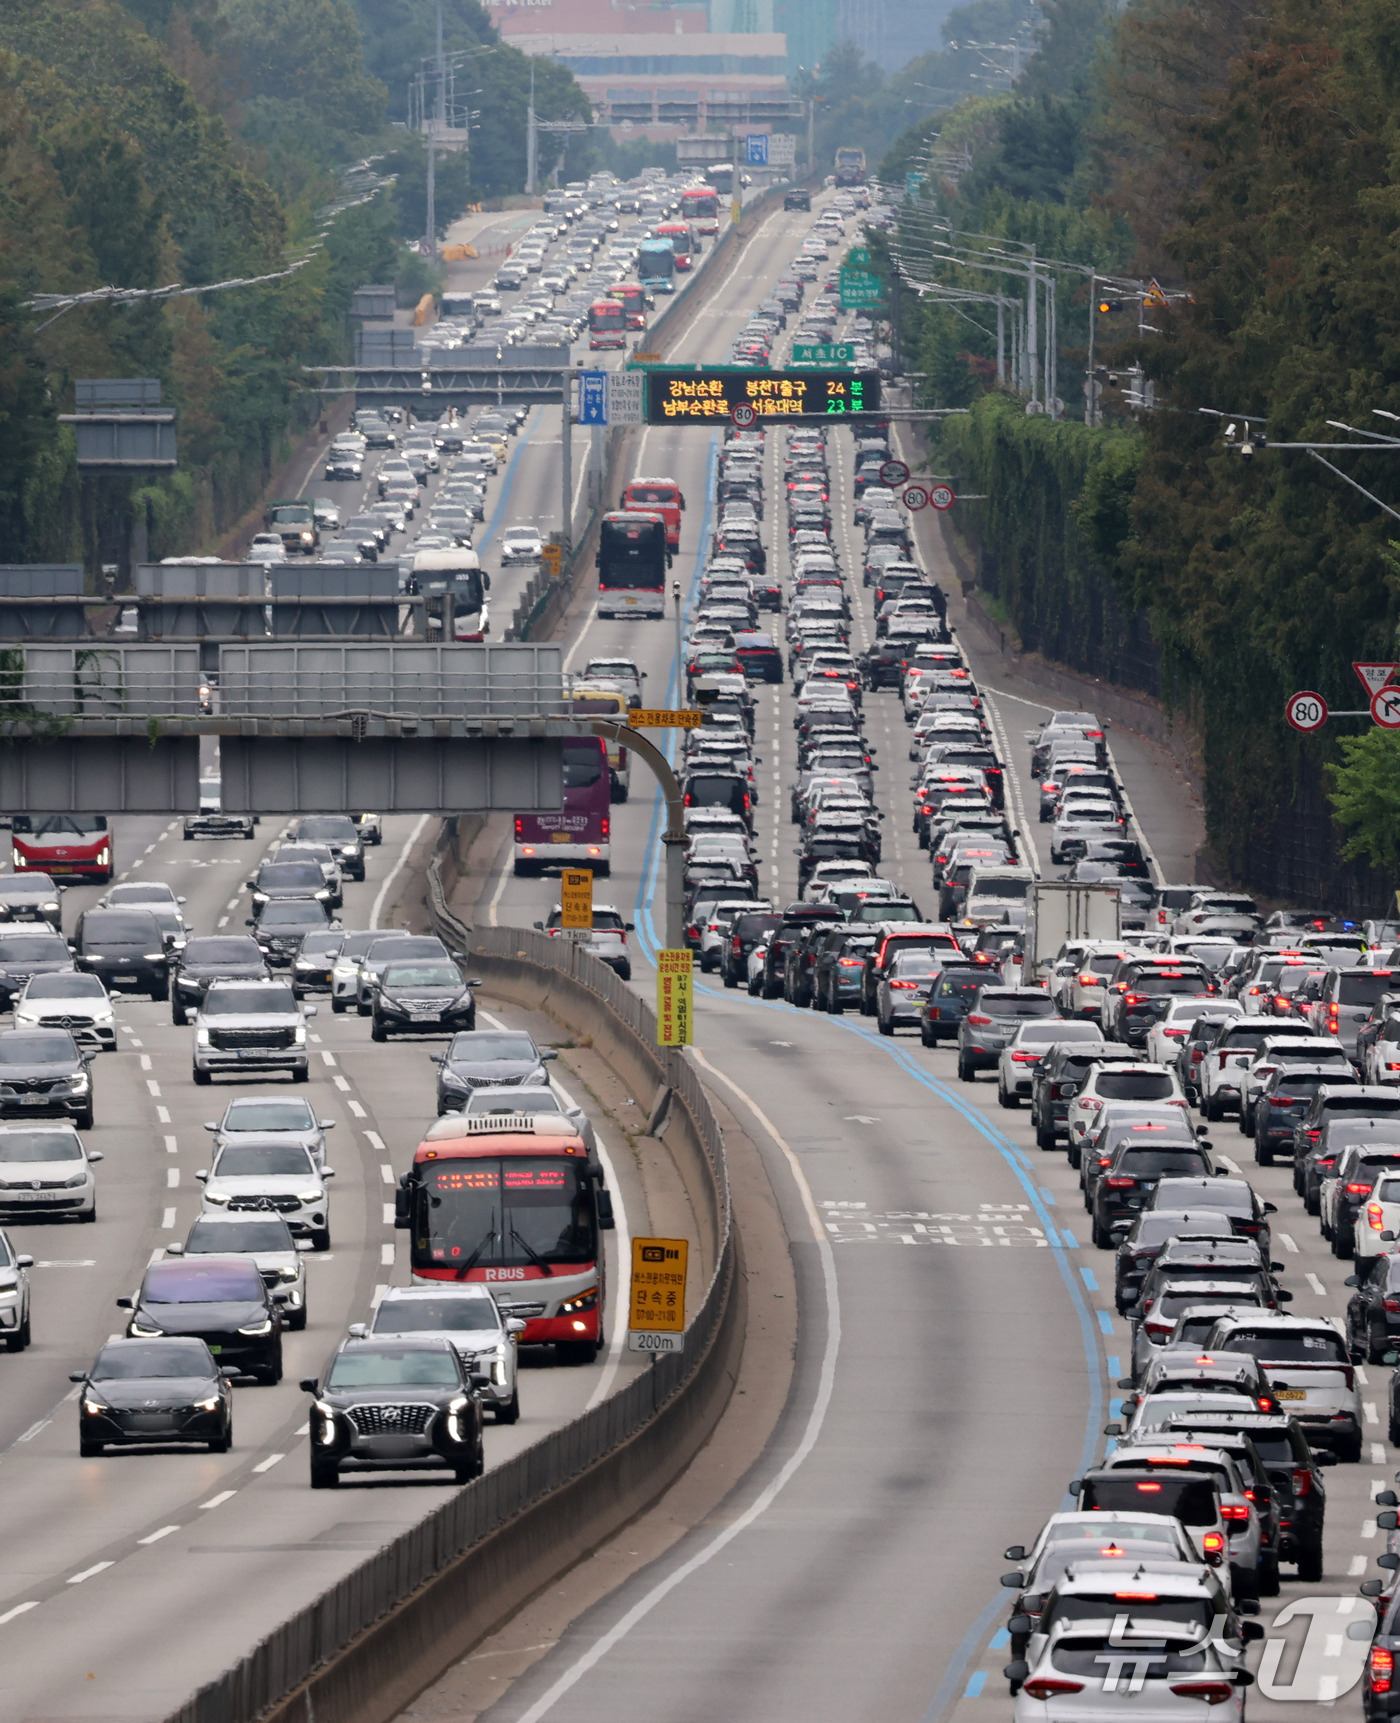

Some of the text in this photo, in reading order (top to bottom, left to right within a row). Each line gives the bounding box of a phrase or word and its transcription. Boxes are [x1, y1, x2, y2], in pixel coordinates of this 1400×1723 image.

[669, 380, 864, 397] 강남순환 봉천T출구 24 분
[662, 399, 864, 416] 남부순환로 서울대역 23 분
[736, 409, 751, 420] 80
[907, 492, 924, 505] 80
[1365, 669, 1387, 677] 양보
[1295, 702, 1319, 722] 80
[678, 713, 699, 725] 단속중
[567, 929, 587, 939] 1km
[637, 1290, 677, 1306] 단속중
[638, 1335, 674, 1349] 200m
